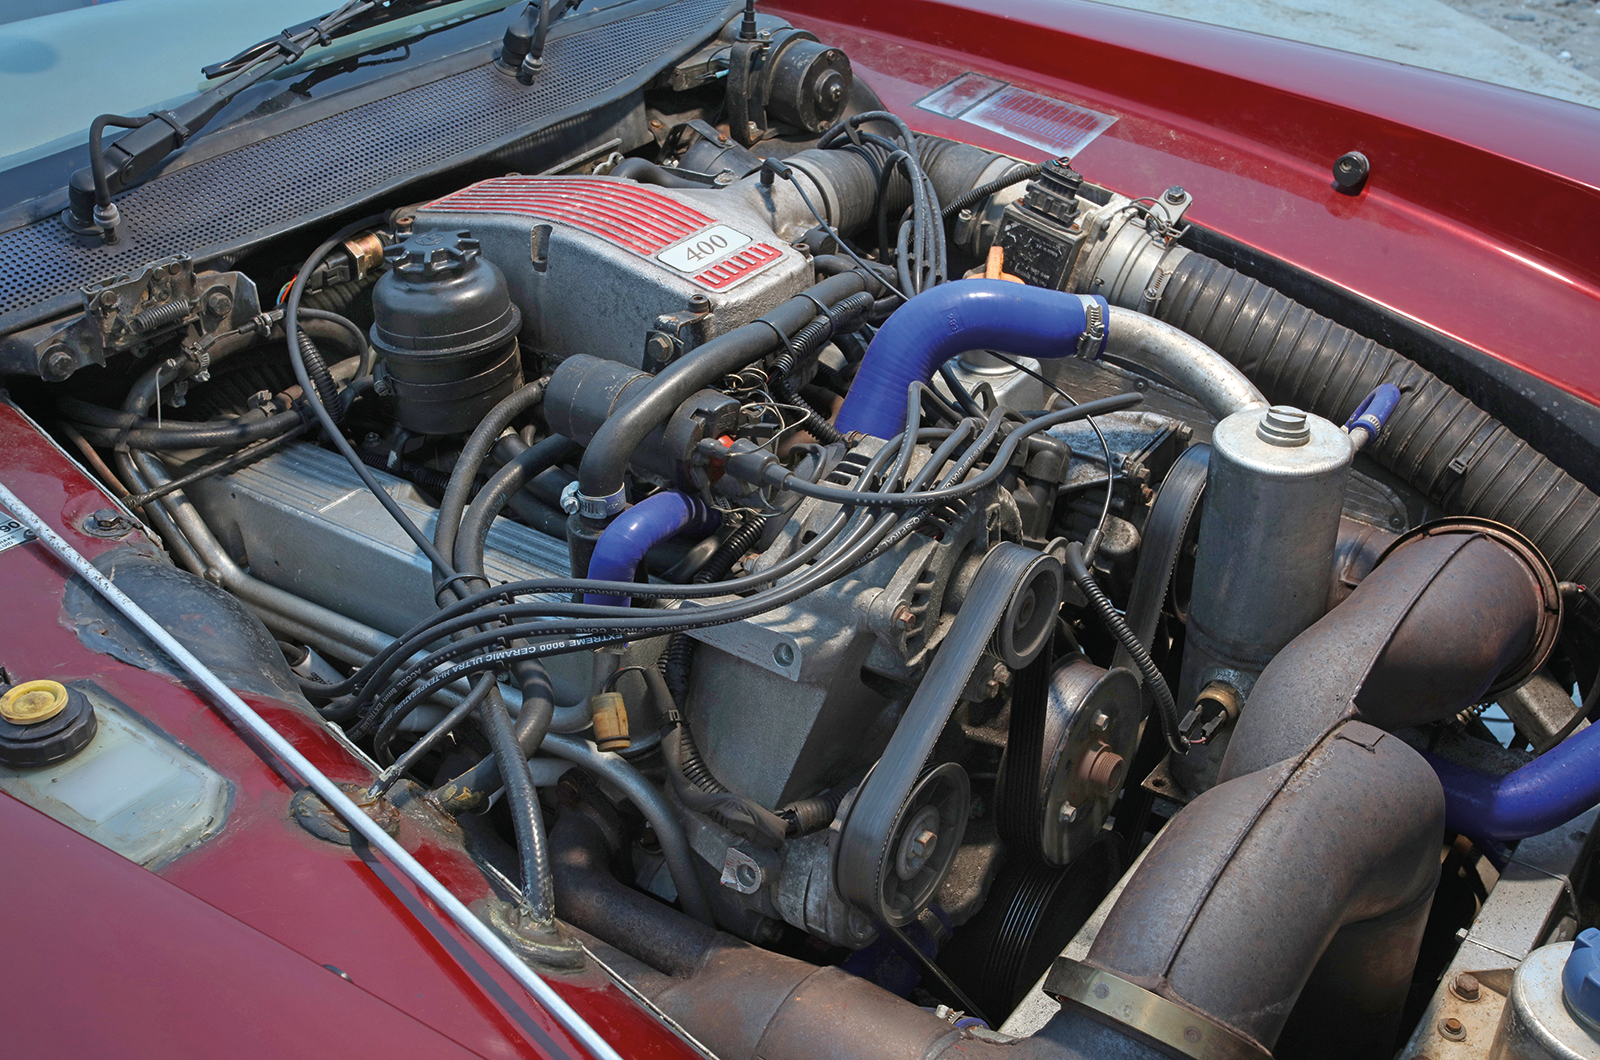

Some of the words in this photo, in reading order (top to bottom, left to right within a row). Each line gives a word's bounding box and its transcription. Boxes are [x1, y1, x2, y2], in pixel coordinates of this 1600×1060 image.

[686, 234, 729, 263] 400
[902, 497, 936, 507] CORE
[853, 547, 880, 567] CORE
[512, 588, 541, 597] CORE
[539, 640, 566, 652] 9000
[569, 634, 623, 648] EXTREME
[485, 646, 537, 662] CERAMIC
[452, 657, 484, 673] ULTRA
[396, 667, 422, 689] ACCEL
[393, 670, 451, 714] HI-TEMPERATURE
[359, 702, 384, 731] EXTREME
